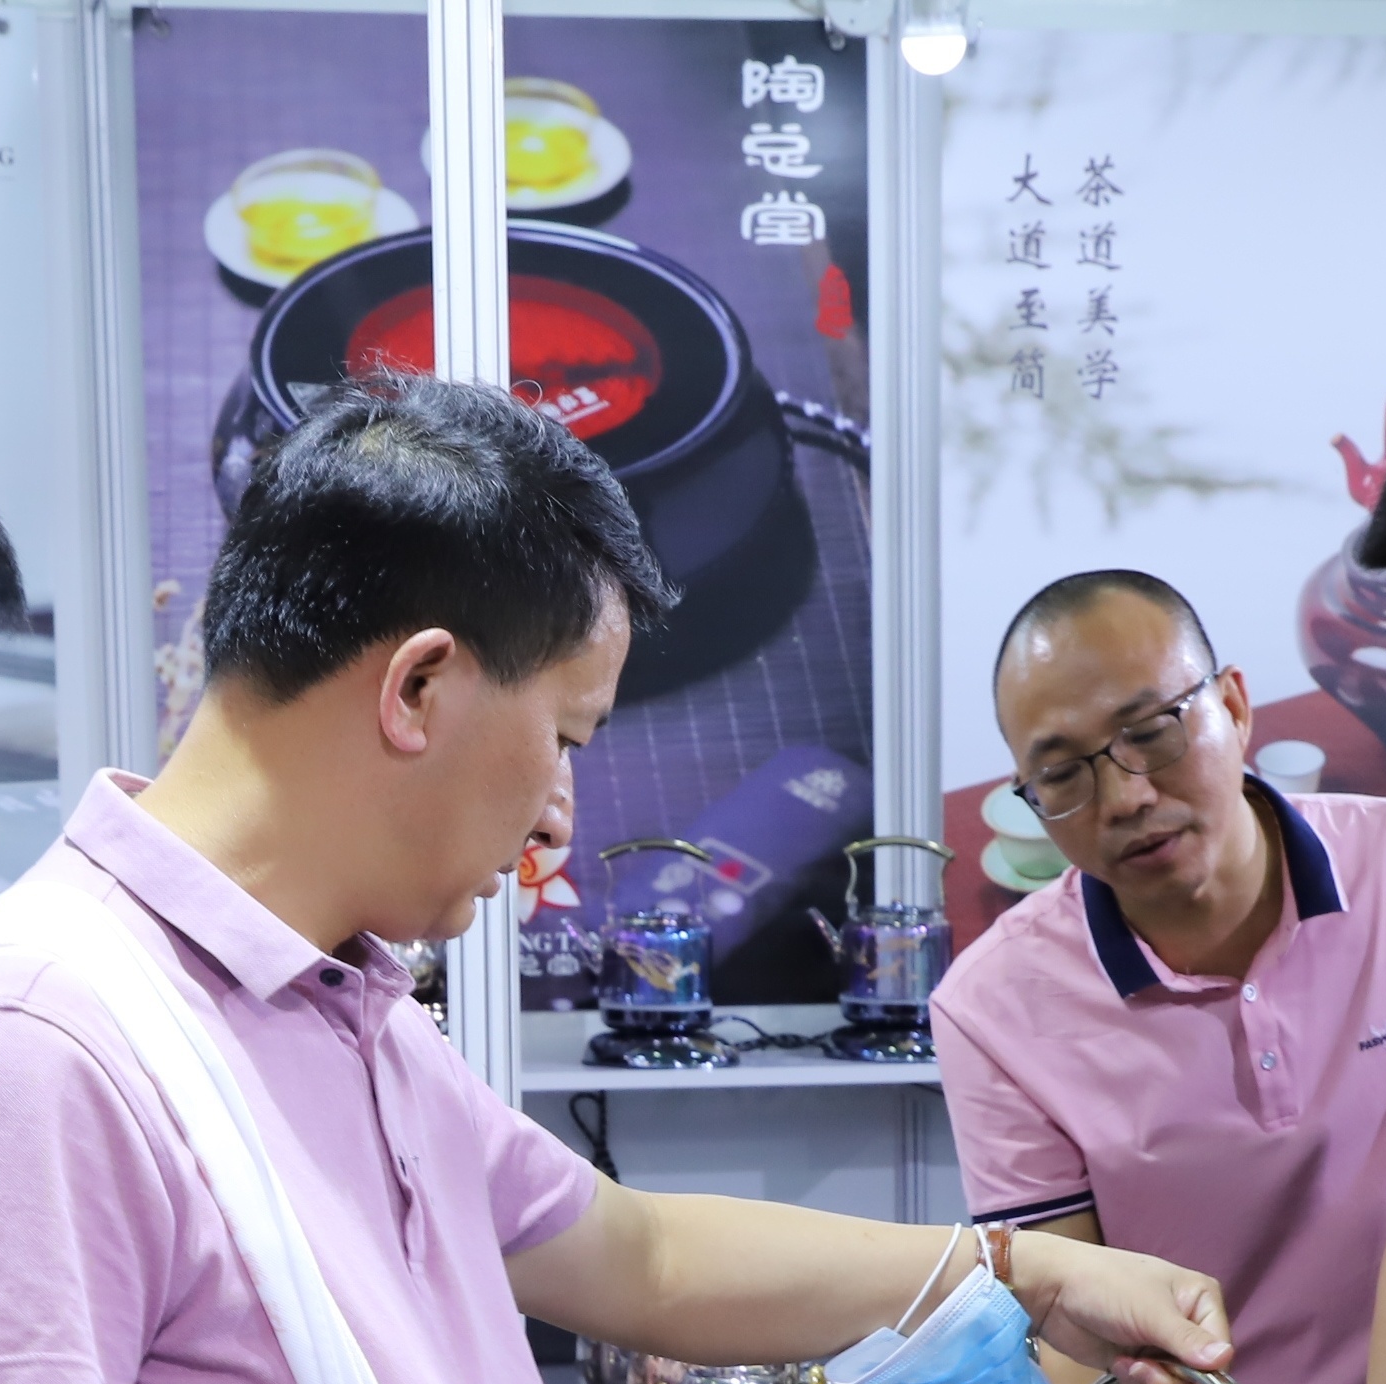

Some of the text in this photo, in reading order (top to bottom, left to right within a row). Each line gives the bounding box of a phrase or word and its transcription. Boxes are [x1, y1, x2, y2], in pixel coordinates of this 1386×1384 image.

[1006, 152, 1054, 399] 大道至简
[1076, 153, 1124, 400] 茶道美学
